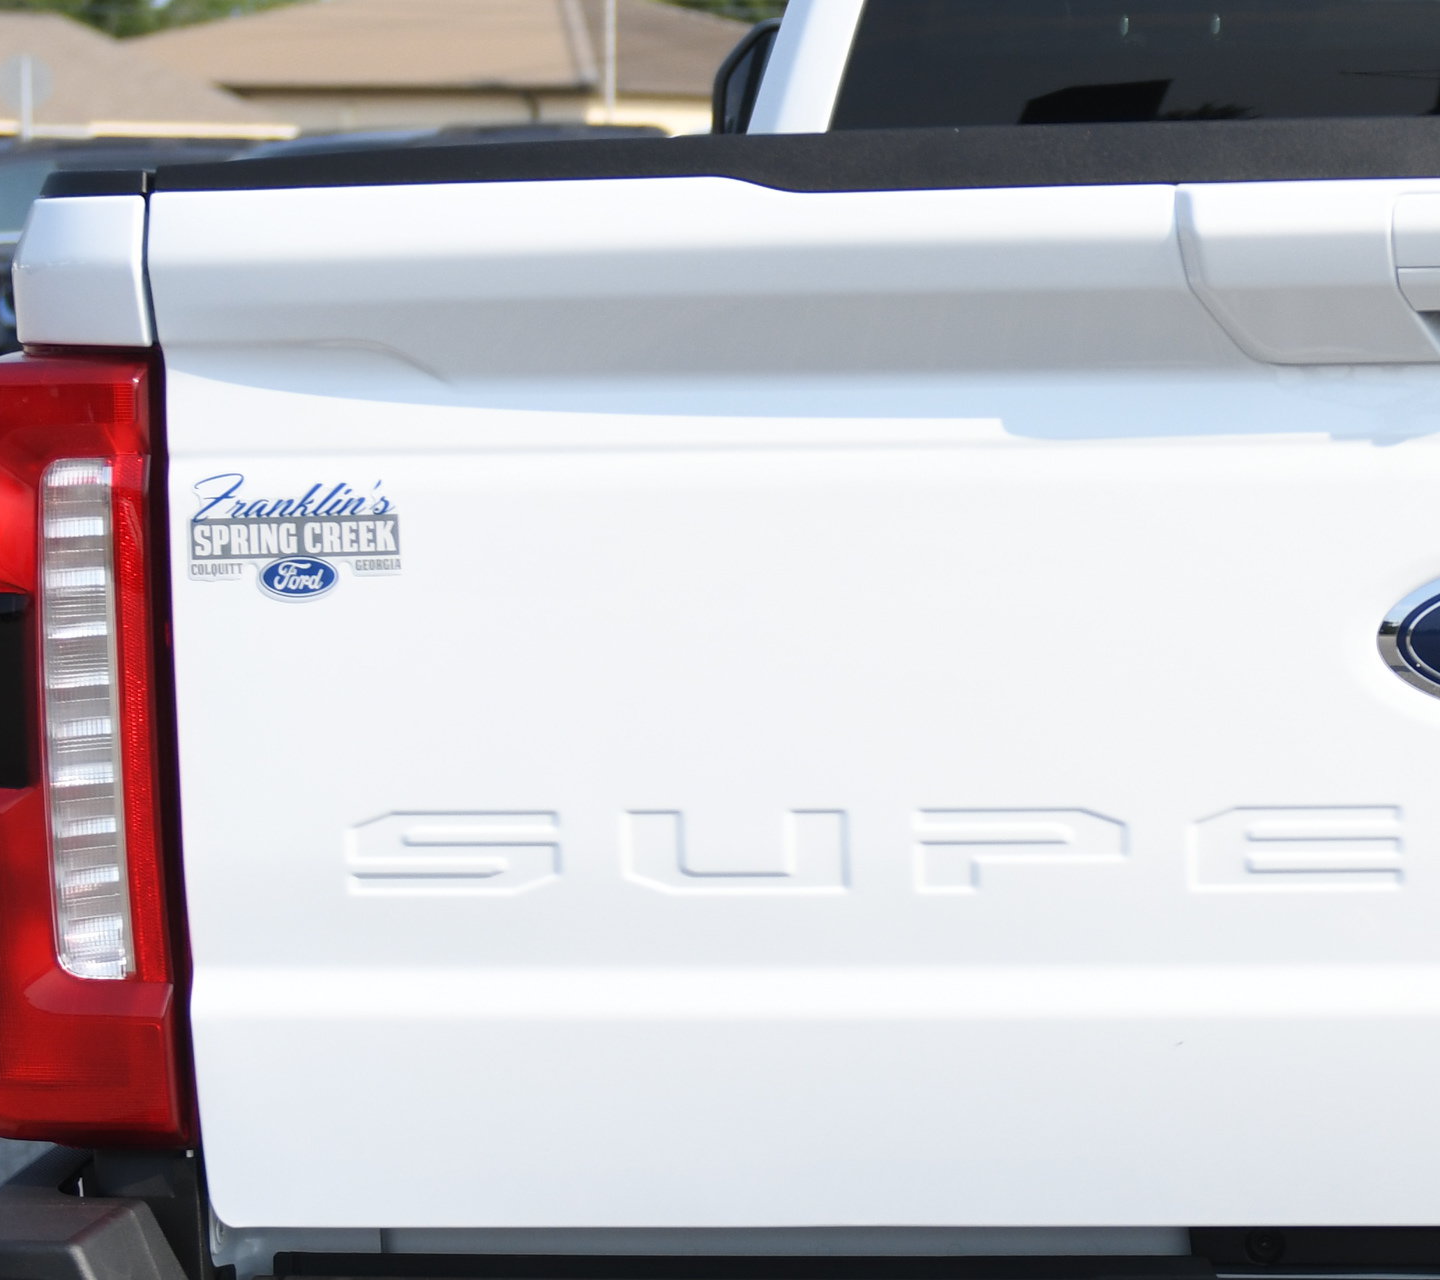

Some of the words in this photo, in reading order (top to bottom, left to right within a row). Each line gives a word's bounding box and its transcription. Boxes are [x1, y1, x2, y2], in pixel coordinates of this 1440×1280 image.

[194, 472, 396, 523] Franklin's
[193, 523, 298, 557] SPRING
[303, 520, 398, 554] CREEK
[191, 562, 243, 577] COLQUITT
[273, 561, 324, 591] Ford
[355, 559, 402, 572] GEORGIA
